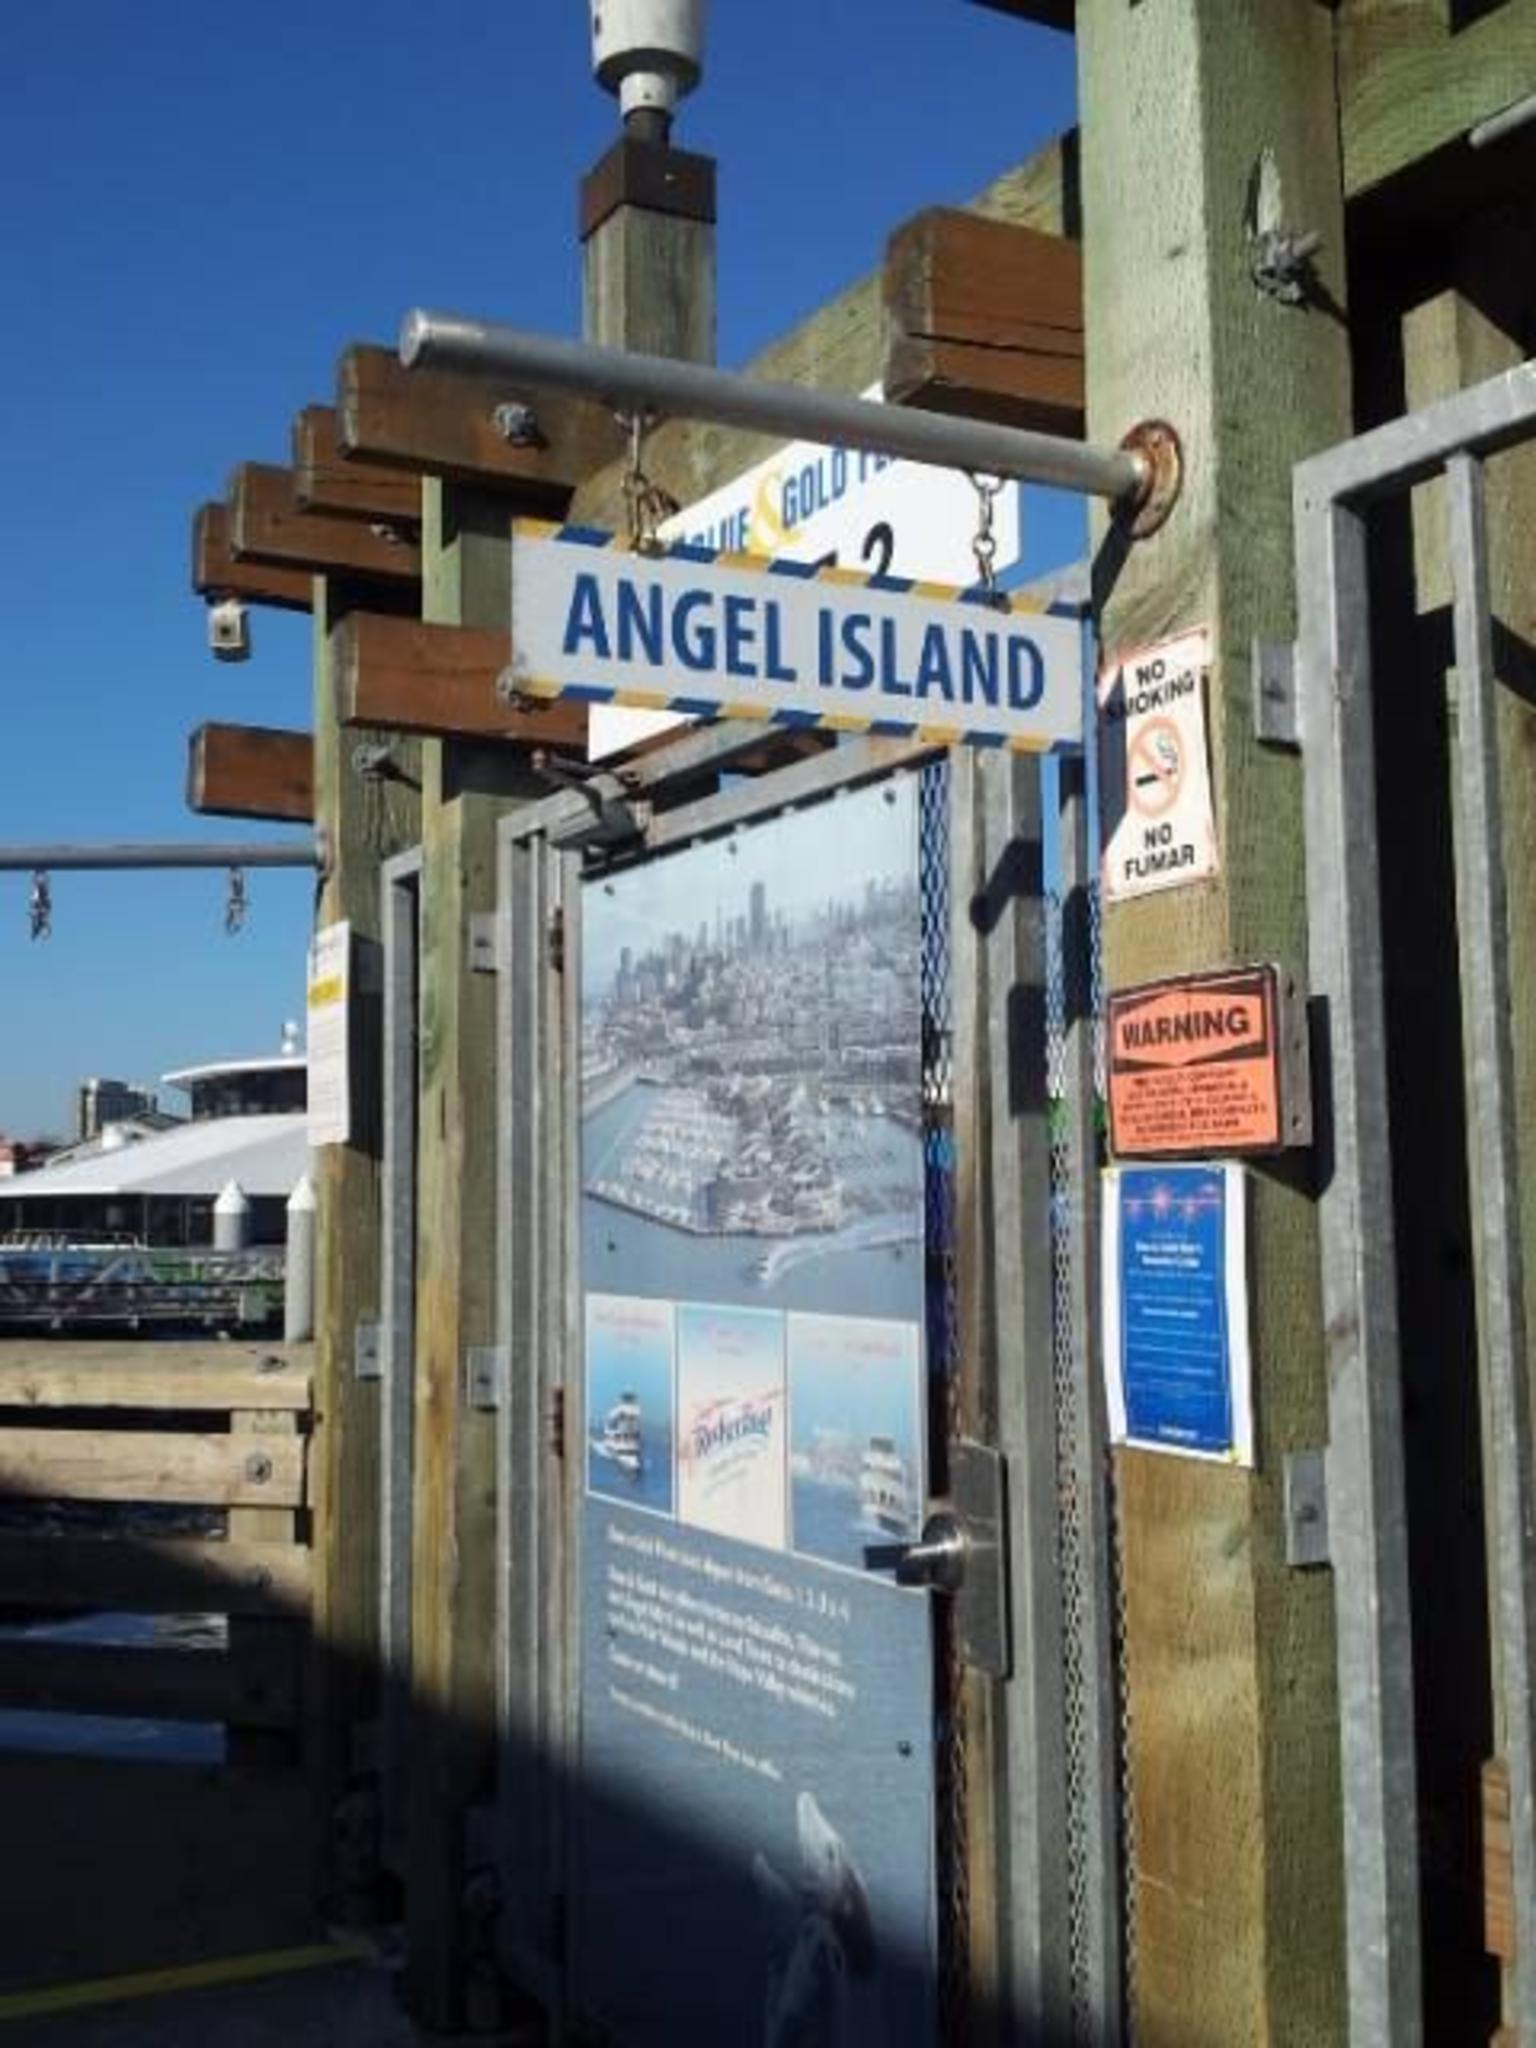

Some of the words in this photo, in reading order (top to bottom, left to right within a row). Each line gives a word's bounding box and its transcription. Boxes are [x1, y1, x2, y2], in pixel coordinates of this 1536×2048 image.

[782, 435, 848, 530] GOLD
[561, 573, 797, 683] ANGEL
[816, 608, 1046, 711] ISLAND
[1120, 669, 1195, 718] OKING
[1135, 659, 1166, 688] NO
[1144, 823, 1173, 849] NO
[1124, 844, 1195, 880] FUMAR
[1122, 1006, 1250, 1050] WARNING
